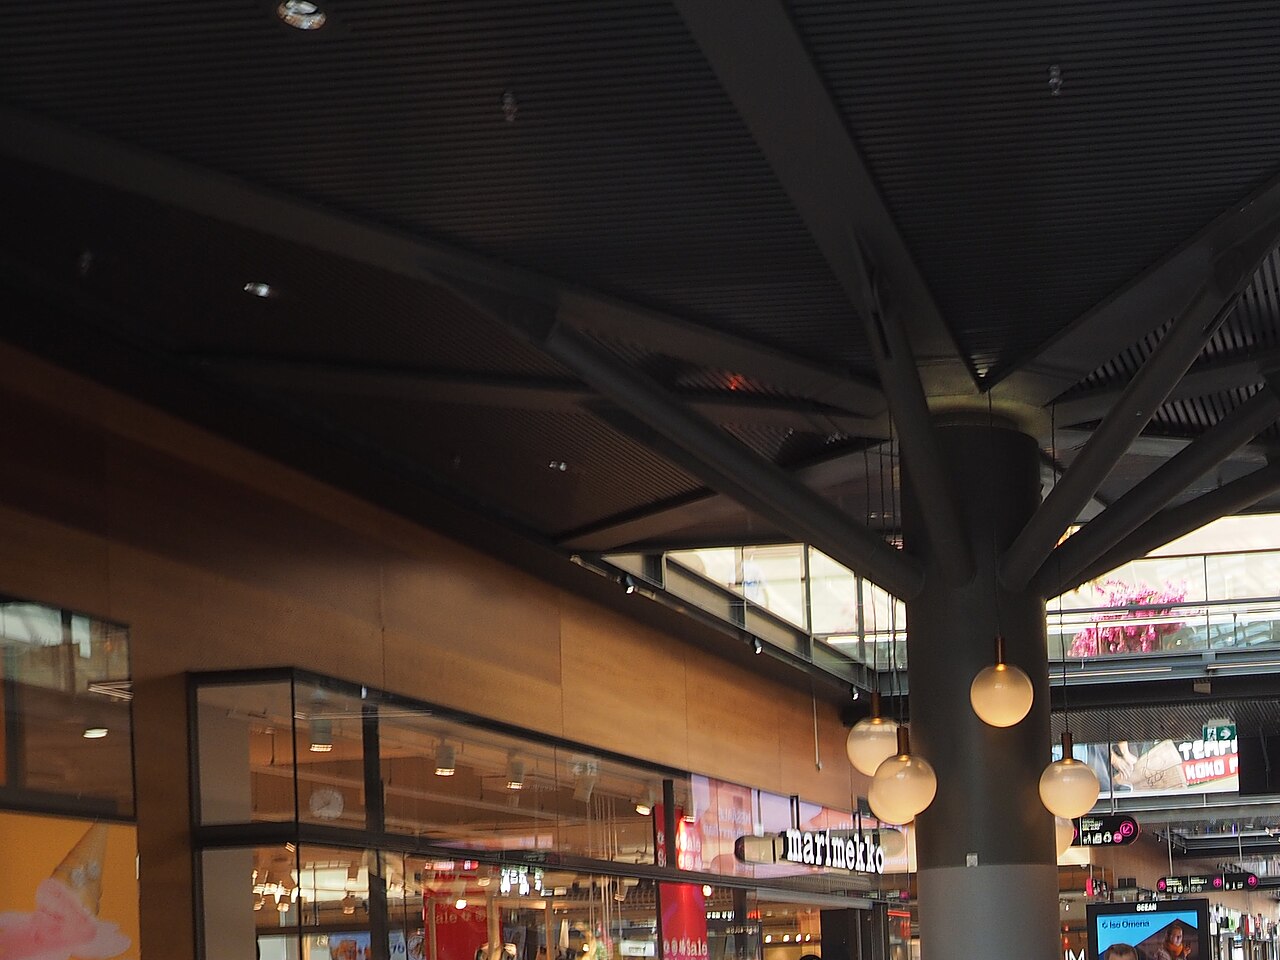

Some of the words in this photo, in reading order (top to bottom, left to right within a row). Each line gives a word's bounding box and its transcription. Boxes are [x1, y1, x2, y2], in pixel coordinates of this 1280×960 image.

[786, 828, 885, 874] marimekko
[1109, 921, 1121, 929] Iso
[1122, 920, 1150, 928] Omena
[686, 939, 707, 955] Sale
